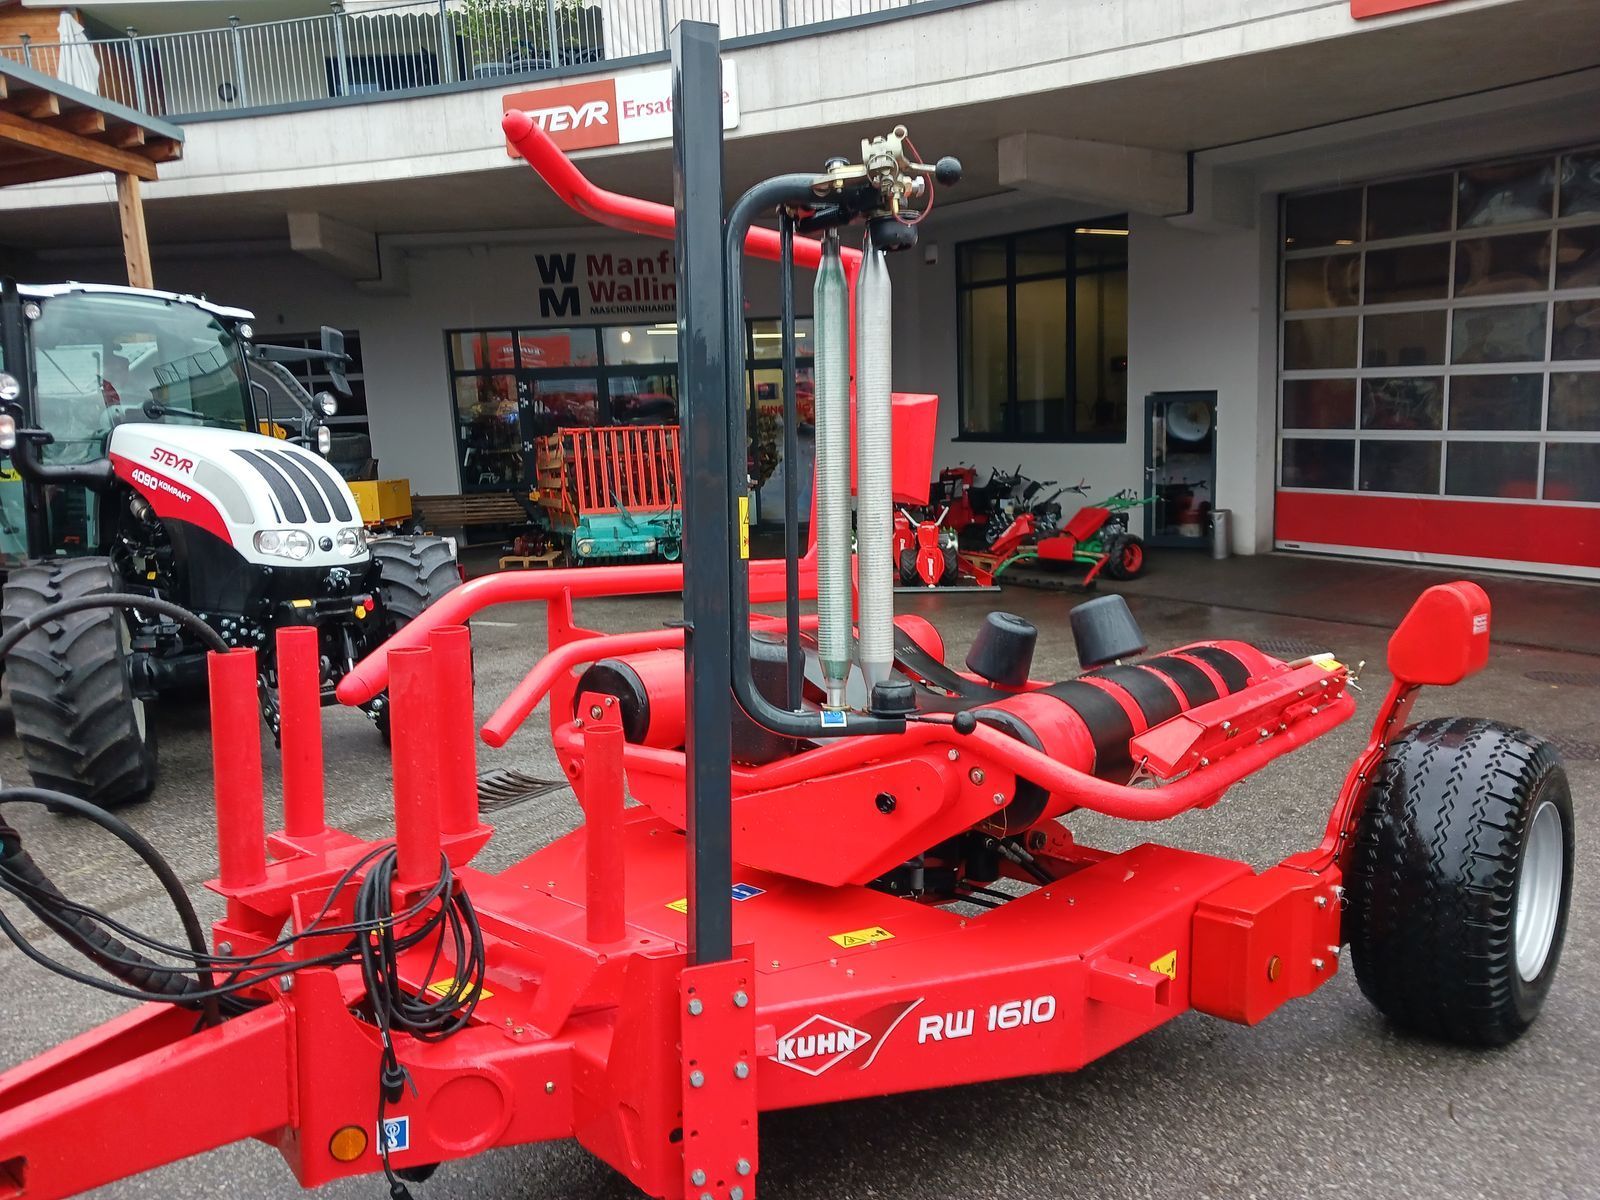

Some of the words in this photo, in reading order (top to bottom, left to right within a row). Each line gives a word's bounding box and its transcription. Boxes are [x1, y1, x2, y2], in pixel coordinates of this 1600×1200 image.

[521, 100, 609, 132] TEYR
[150, 447, 193, 474] STEYR
[131, 468, 158, 491] 4090
[158, 481, 192, 503] KOMPAKT
[917, 1009, 975, 1044] RW
[986, 995, 1057, 1031] 1610
[776, 1029, 857, 1063] KUHN
